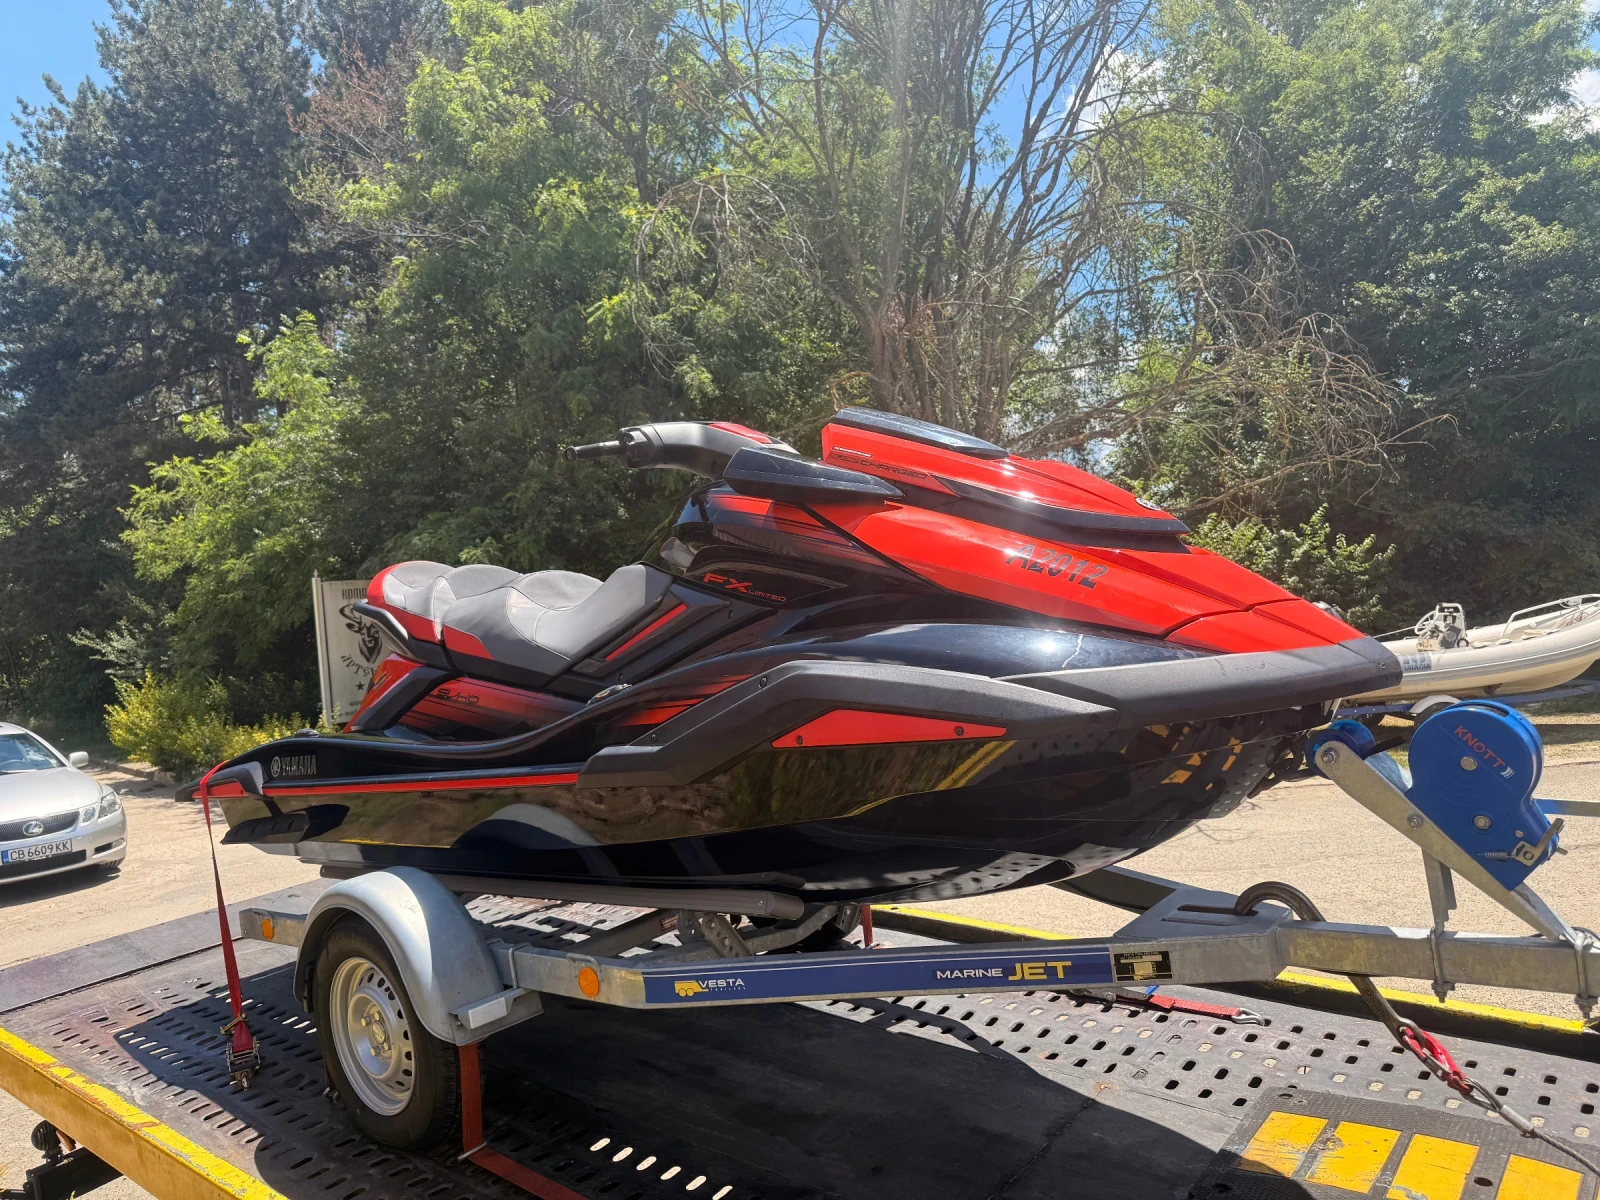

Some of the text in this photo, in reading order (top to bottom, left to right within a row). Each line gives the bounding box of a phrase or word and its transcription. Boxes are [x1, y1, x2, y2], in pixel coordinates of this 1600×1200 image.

[1005, 543, 1108, 589] A2012
[703, 573, 786, 602] FX LIMITED
[1454, 725, 1506, 768] KNOTT
[281, 755, 317, 776] YAMAHA
[10, 840, 72, 861] CB 6609 KK
[936, 961, 1072, 981] MARINE JET
[698, 978, 745, 988] VESTA
